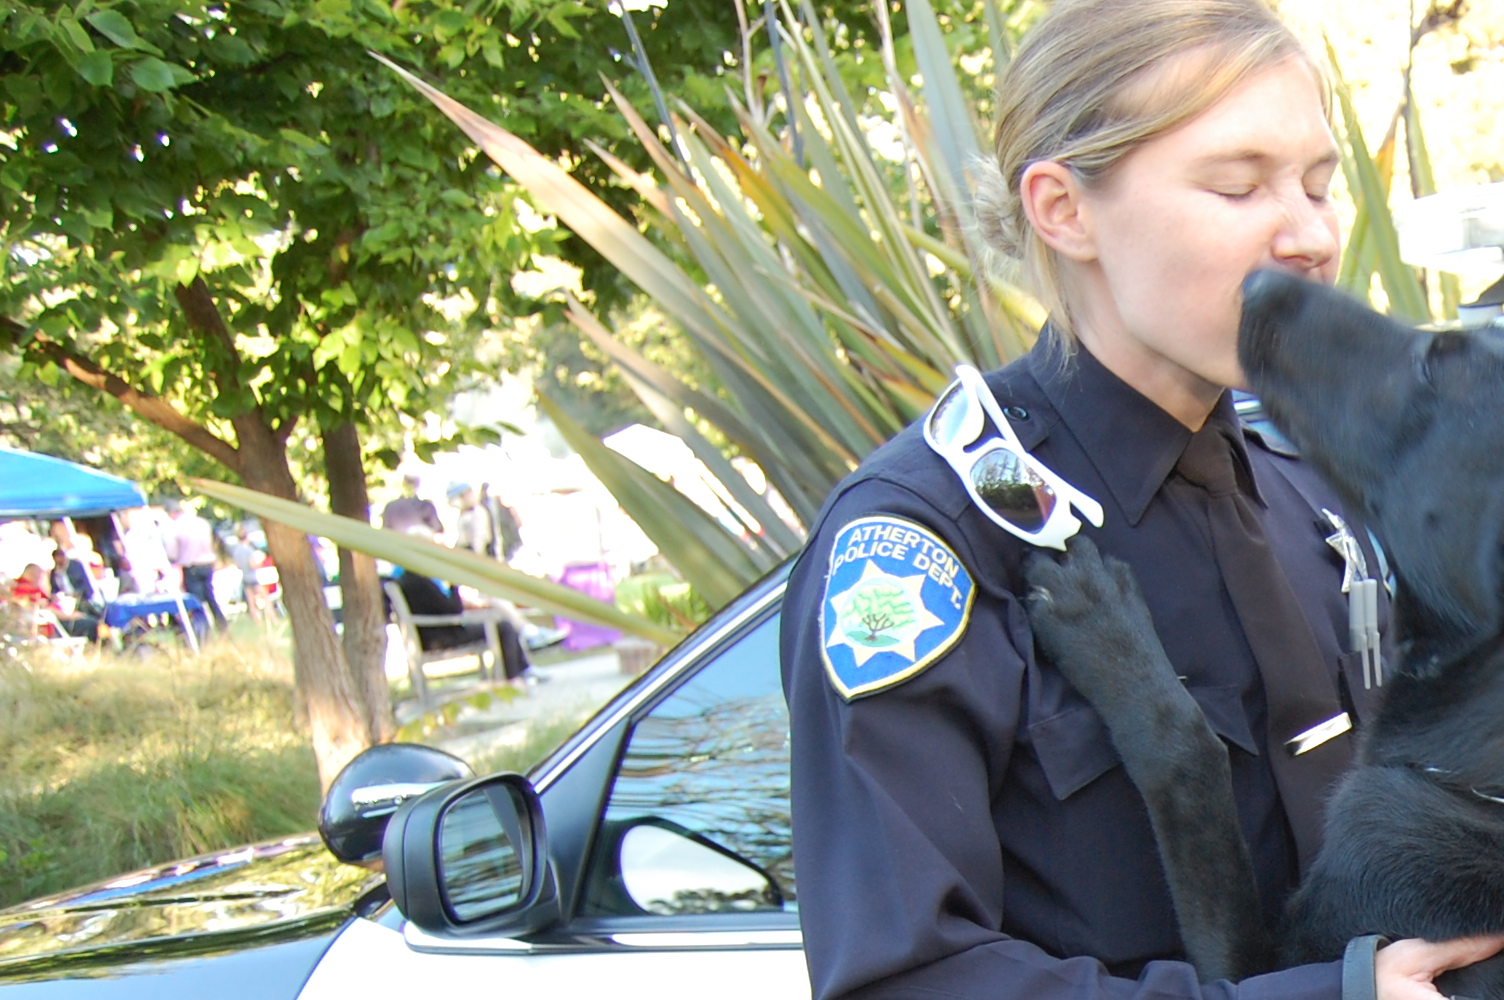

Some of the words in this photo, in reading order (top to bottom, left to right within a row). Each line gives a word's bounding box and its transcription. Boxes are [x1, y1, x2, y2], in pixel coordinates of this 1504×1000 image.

[833, 542, 908, 576] POLICE
[912, 553, 963, 610] DEPT.
[848, 526, 960, 577] ATHERTON
